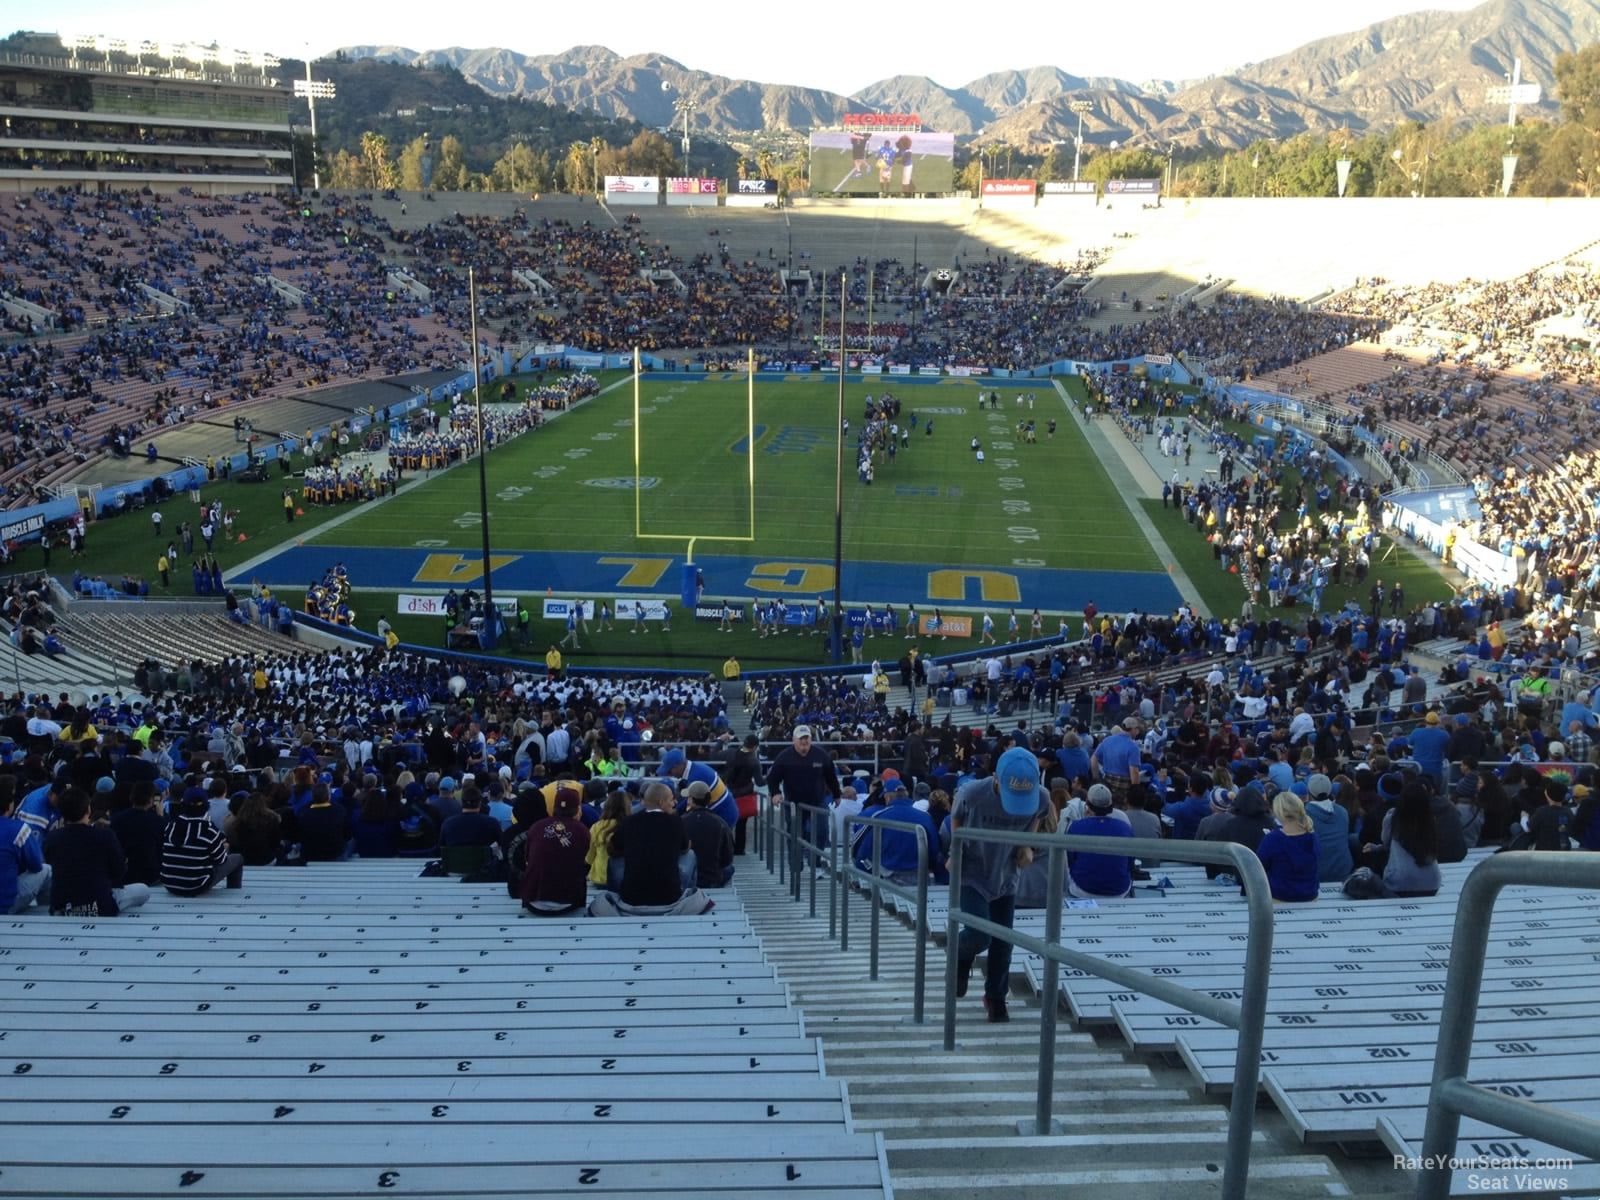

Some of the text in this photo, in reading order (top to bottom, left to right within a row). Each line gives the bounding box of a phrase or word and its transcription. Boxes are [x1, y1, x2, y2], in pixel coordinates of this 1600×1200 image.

[843, 113, 922, 126] HONDA
[700, 182, 717, 192] ICE
[1145, 355, 1171, 364] HONDA
[1001, 500, 1032, 515] 20
[1, 514, 45, 542] MUSCLE MILK
[1007, 526, 1041, 544] 10
[407, 597, 437, 612] dish
[548, 605, 565, 613] UCLA
[695, 607, 723, 618] MUSCLE
[1334, 963, 1363, 972] 104
[1504, 958, 1533, 966] 106
[1151, 967, 1182, 975] 102
[1415, 984, 1446, 992] 104
[1510, 979, 1544, 988] 105
[1107, 994, 1139, 1002] 101
[1208, 991, 1242, 1000] 102
[1314, 988, 1348, 997] 103
[196, 1003, 211, 1011] 6
[307, 1003, 321, 1011] 5
[416, 1002, 429, 1010] 4
[516, 1001, 528, 1009] 3
[624, 998, 637, 1007] 2
[1390, 1012, 1429, 1022] 103
[1510, 1006, 1549, 1017] 104
[1163, 1016, 1201, 1026] 101
[1277, 1015, 1318, 1025] 102
[494, 1032, 508, 1041] 3
[613, 1029, 627, 1038] 2
[739, 1027, 749, 1036] 1
[246, 1034, 262, 1043] 5
[370, 1034, 386, 1043] 4
[1366, 1046, 1411, 1058] 102
[1495, 1042, 1539, 1054] 103
[308, 1062, 326, 1073] 4
[457, 1061, 472, 1072] 3
[601, 1059, 616, 1070] 2
[750, 1057, 760, 1068] 1
[13, 1063, 32, 1074] 6
[159, 1063, 179, 1075] 5
[1338, 1090, 1388, 1105] 101
[108, 1106, 131, 1119] 5
[273, 1105, 296, 1119] 4
[431, 1105, 450, 1117] 3
[593, 1105, 612, 1117] 2
[767, 1104, 780, 1117] 1
[1470, 1142, 1531, 1158] 101
[578, 1168, 600, 1184] 2
[786, 1163, 802, 1181] 1
[179, 1170, 205, 1188] 4
[377, 1171, 400, 1188] 3
